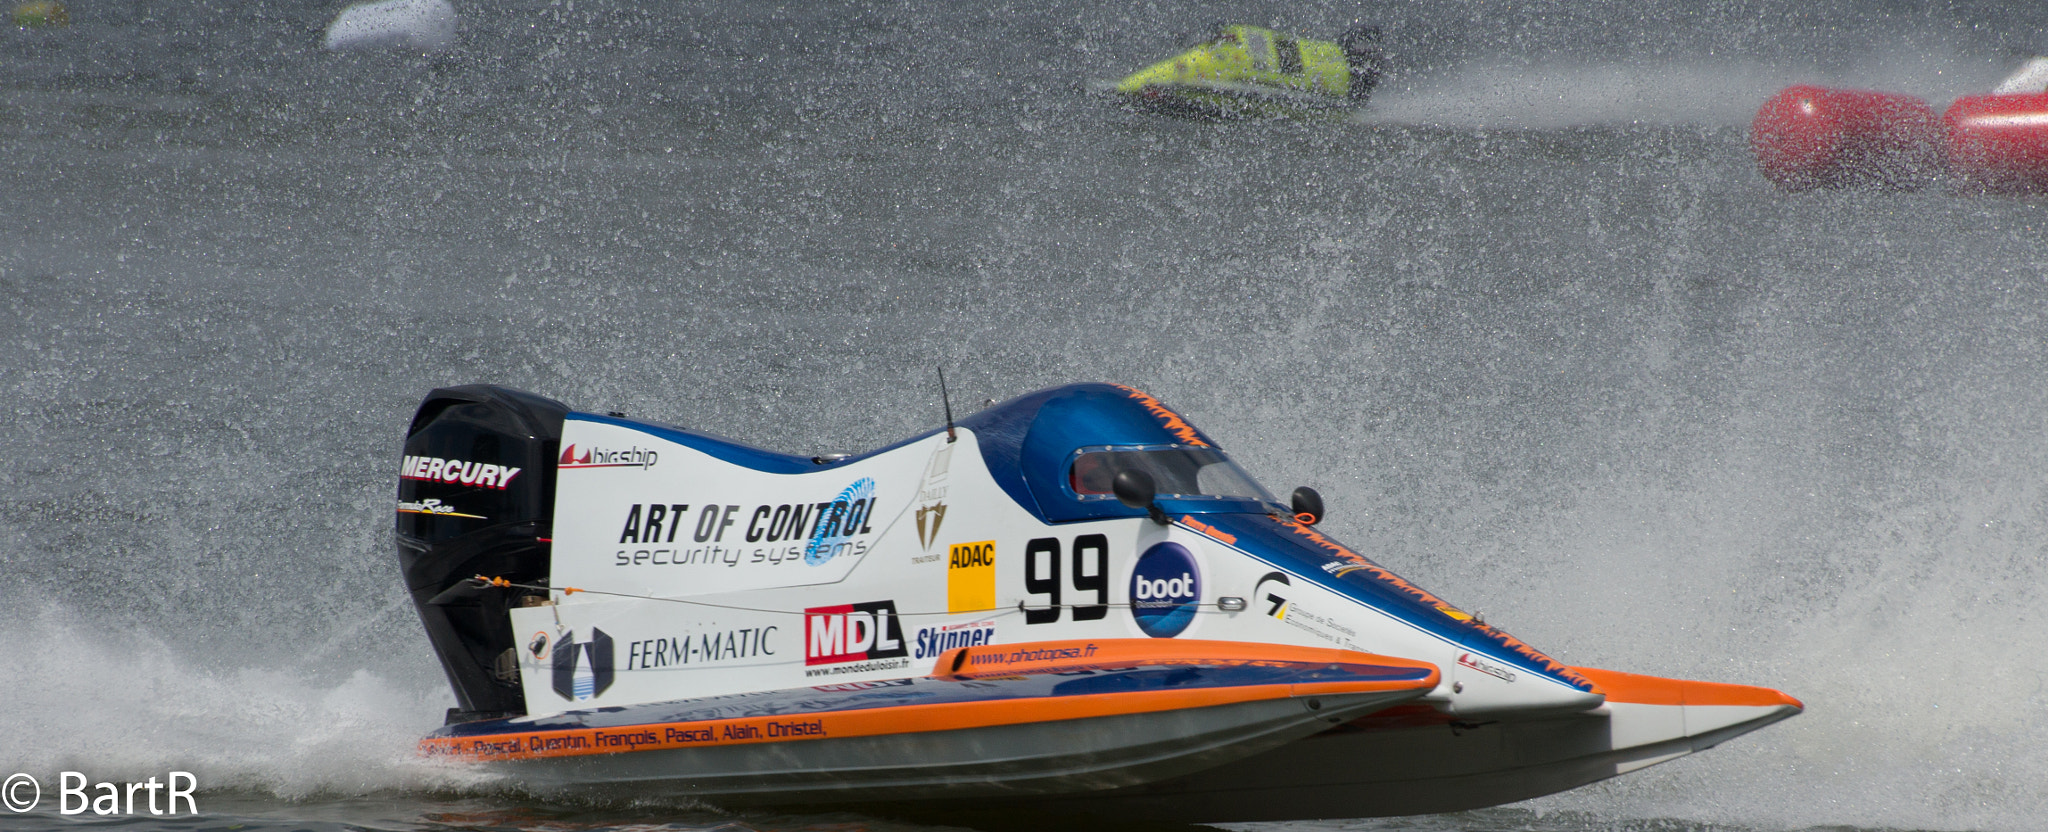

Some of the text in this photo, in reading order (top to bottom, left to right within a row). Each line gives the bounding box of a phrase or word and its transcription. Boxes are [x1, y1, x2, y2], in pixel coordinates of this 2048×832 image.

[401, 455, 522, 490] MERCURY
[619, 497, 877, 544] ART OF CONTROL
[616, 540, 867, 567] security systems
[950, 544, 993, 569] ADAC
[1025, 533, 1108, 625] 99
[1136, 572, 1194, 599] boot
[628, 626, 778, 670] FERM-MATIC
[809, 608, 899, 658] MDL
[915, 626, 995, 659] Skinner
[805, 658, 909, 677] www.mondeduloisir.fr
[971, 644, 1098, 665] www.photopsa.fr
[595, 732, 661, 749] François,
[666, 726, 718, 743] Pascal,
[723, 724, 763, 741] Alain,
[767, 719, 827, 737] Christel,
